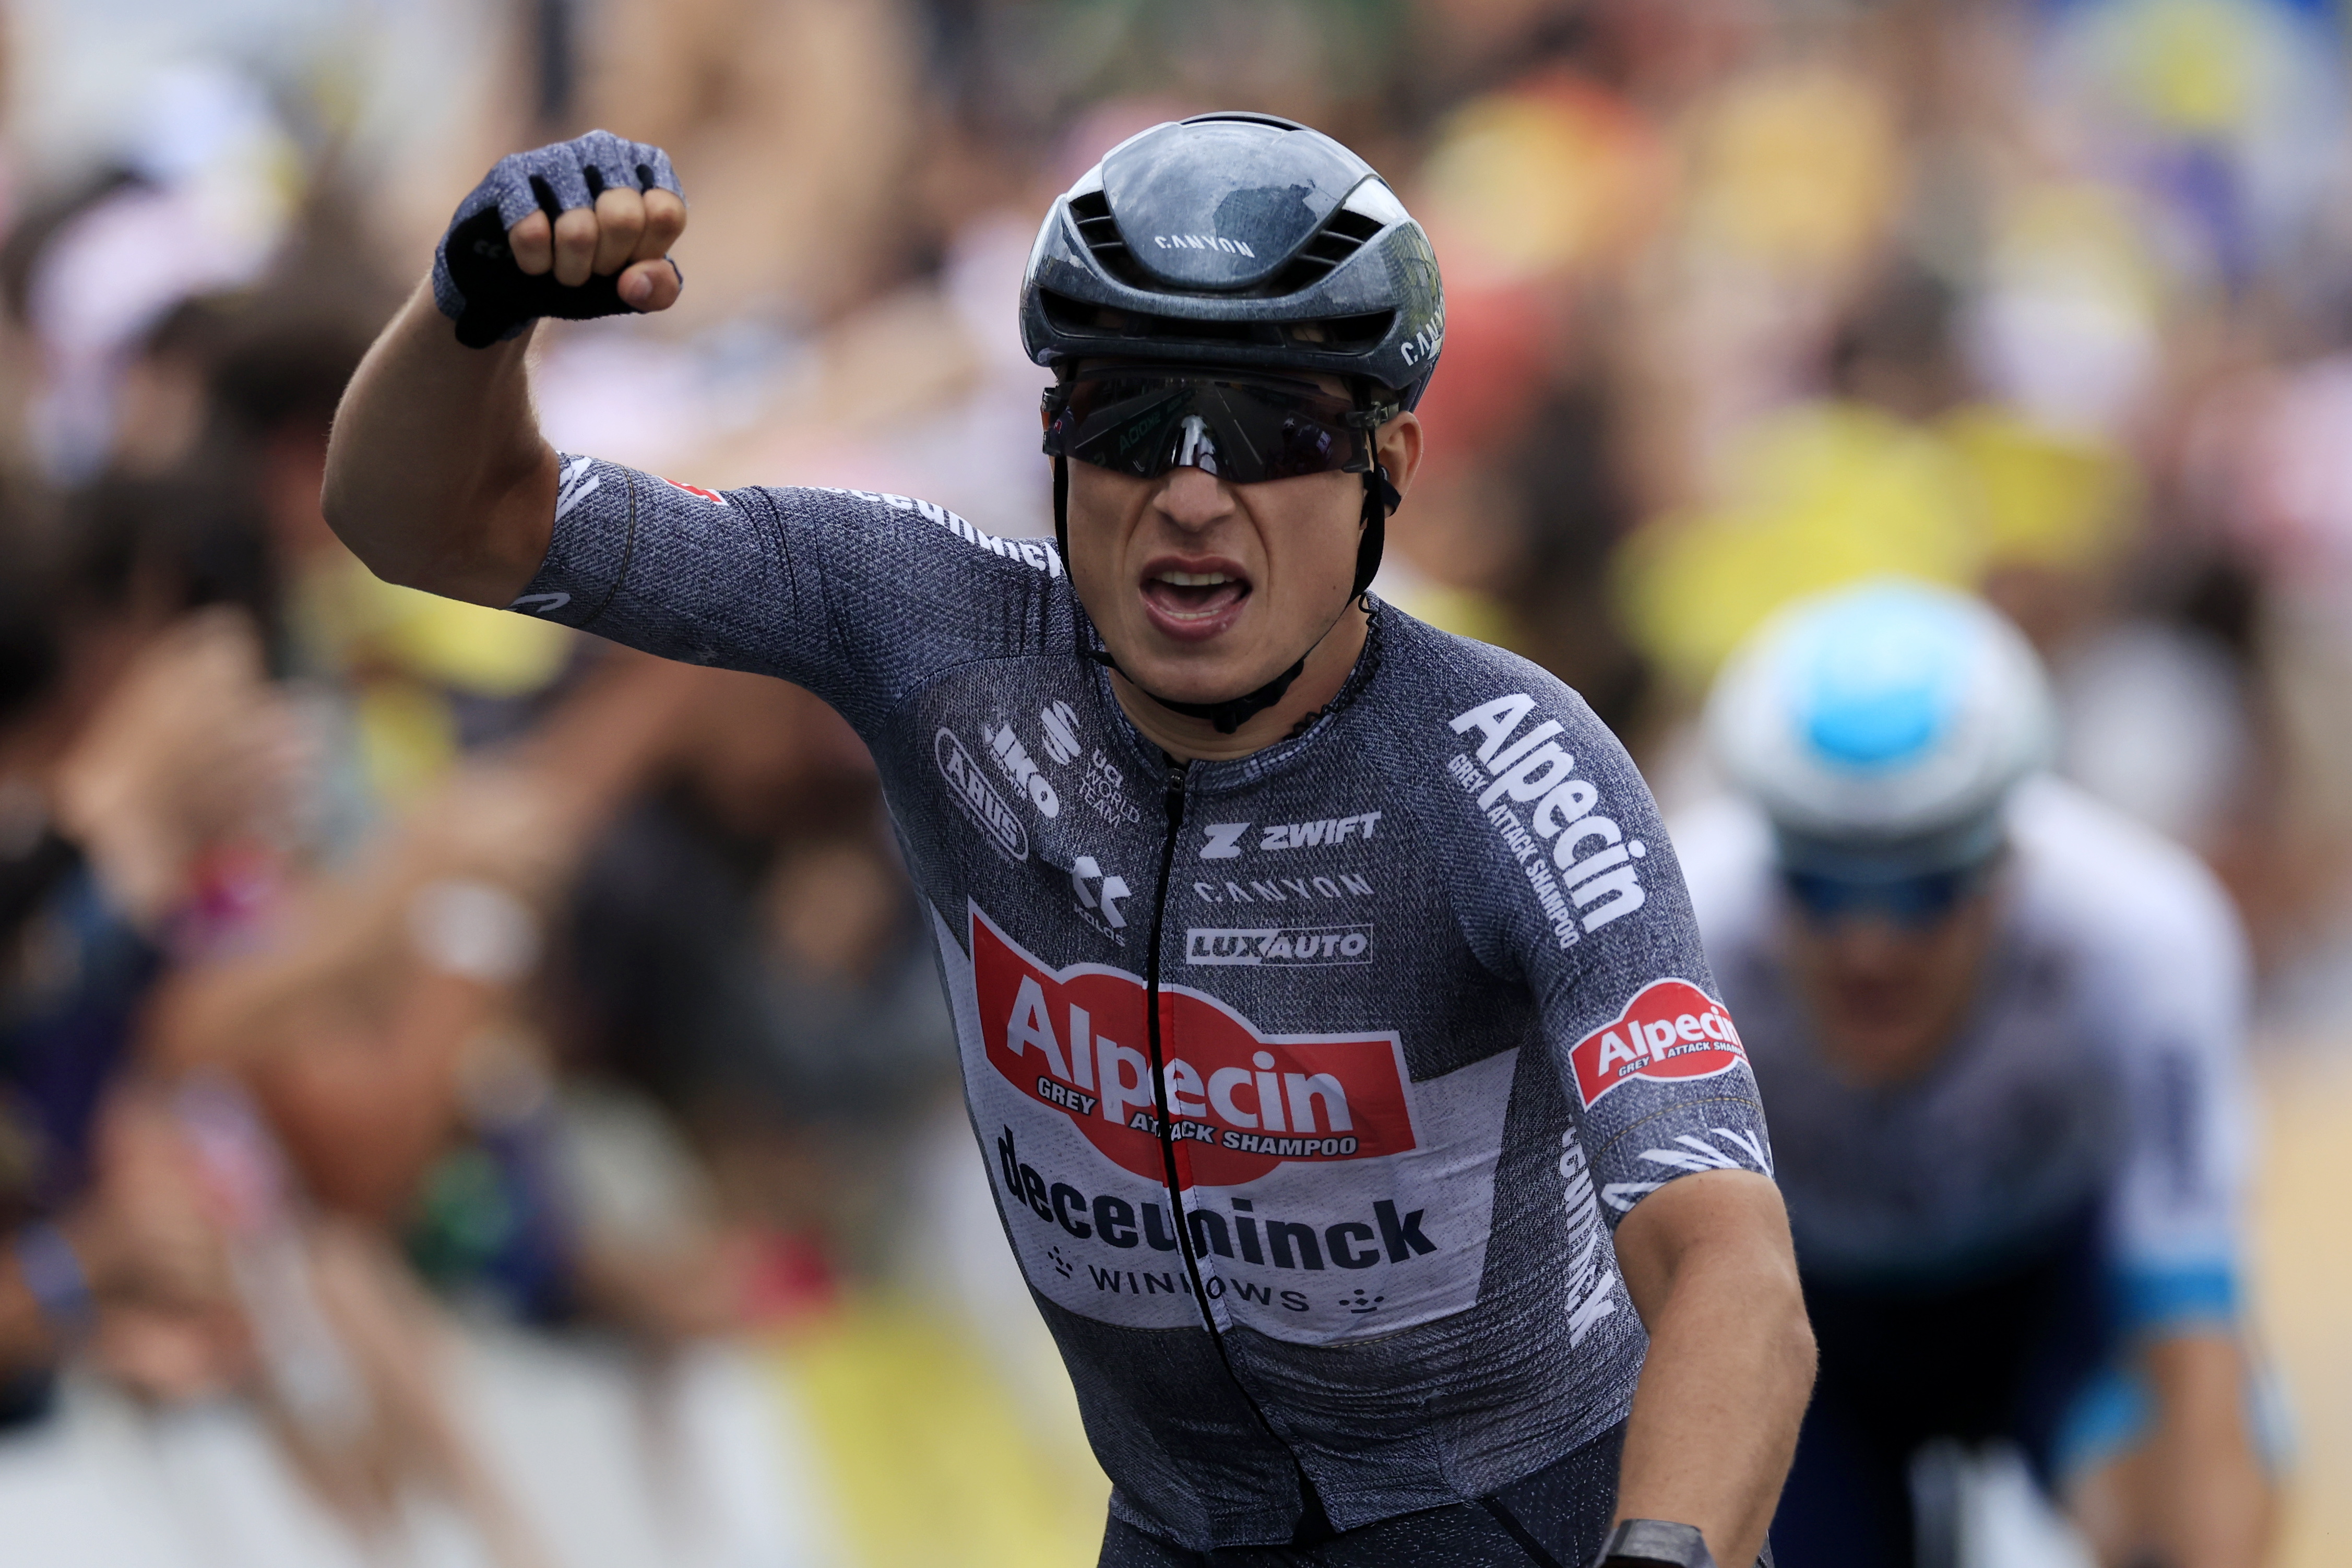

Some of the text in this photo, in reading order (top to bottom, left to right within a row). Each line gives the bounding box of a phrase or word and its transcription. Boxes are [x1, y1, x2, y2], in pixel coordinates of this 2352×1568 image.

[1155, 234, 1255, 258] CANYON
[947, 747, 1017, 847] ABUS
[1079, 777, 1121, 828] TEAM
[1086, 761, 1139, 823] WORLD
[1449, 693, 1646, 934] Alpecin
[1260, 811, 1382, 850] ZWIFT
[1448, 753, 1580, 949] GREY ATTACK SHAMPOO
[1194, 873, 1374, 903] CANYON
[1007, 973, 1354, 1133] Alpecin
[1598, 1005, 1744, 1077] Alpecin
[1618, 1056, 1650, 1077] GREY
[1667, 1041, 1711, 1059] ATTACK
[1037, 1077, 1098, 1115] GREY
[1222, 1131, 1357, 1156] SHAMPOO
